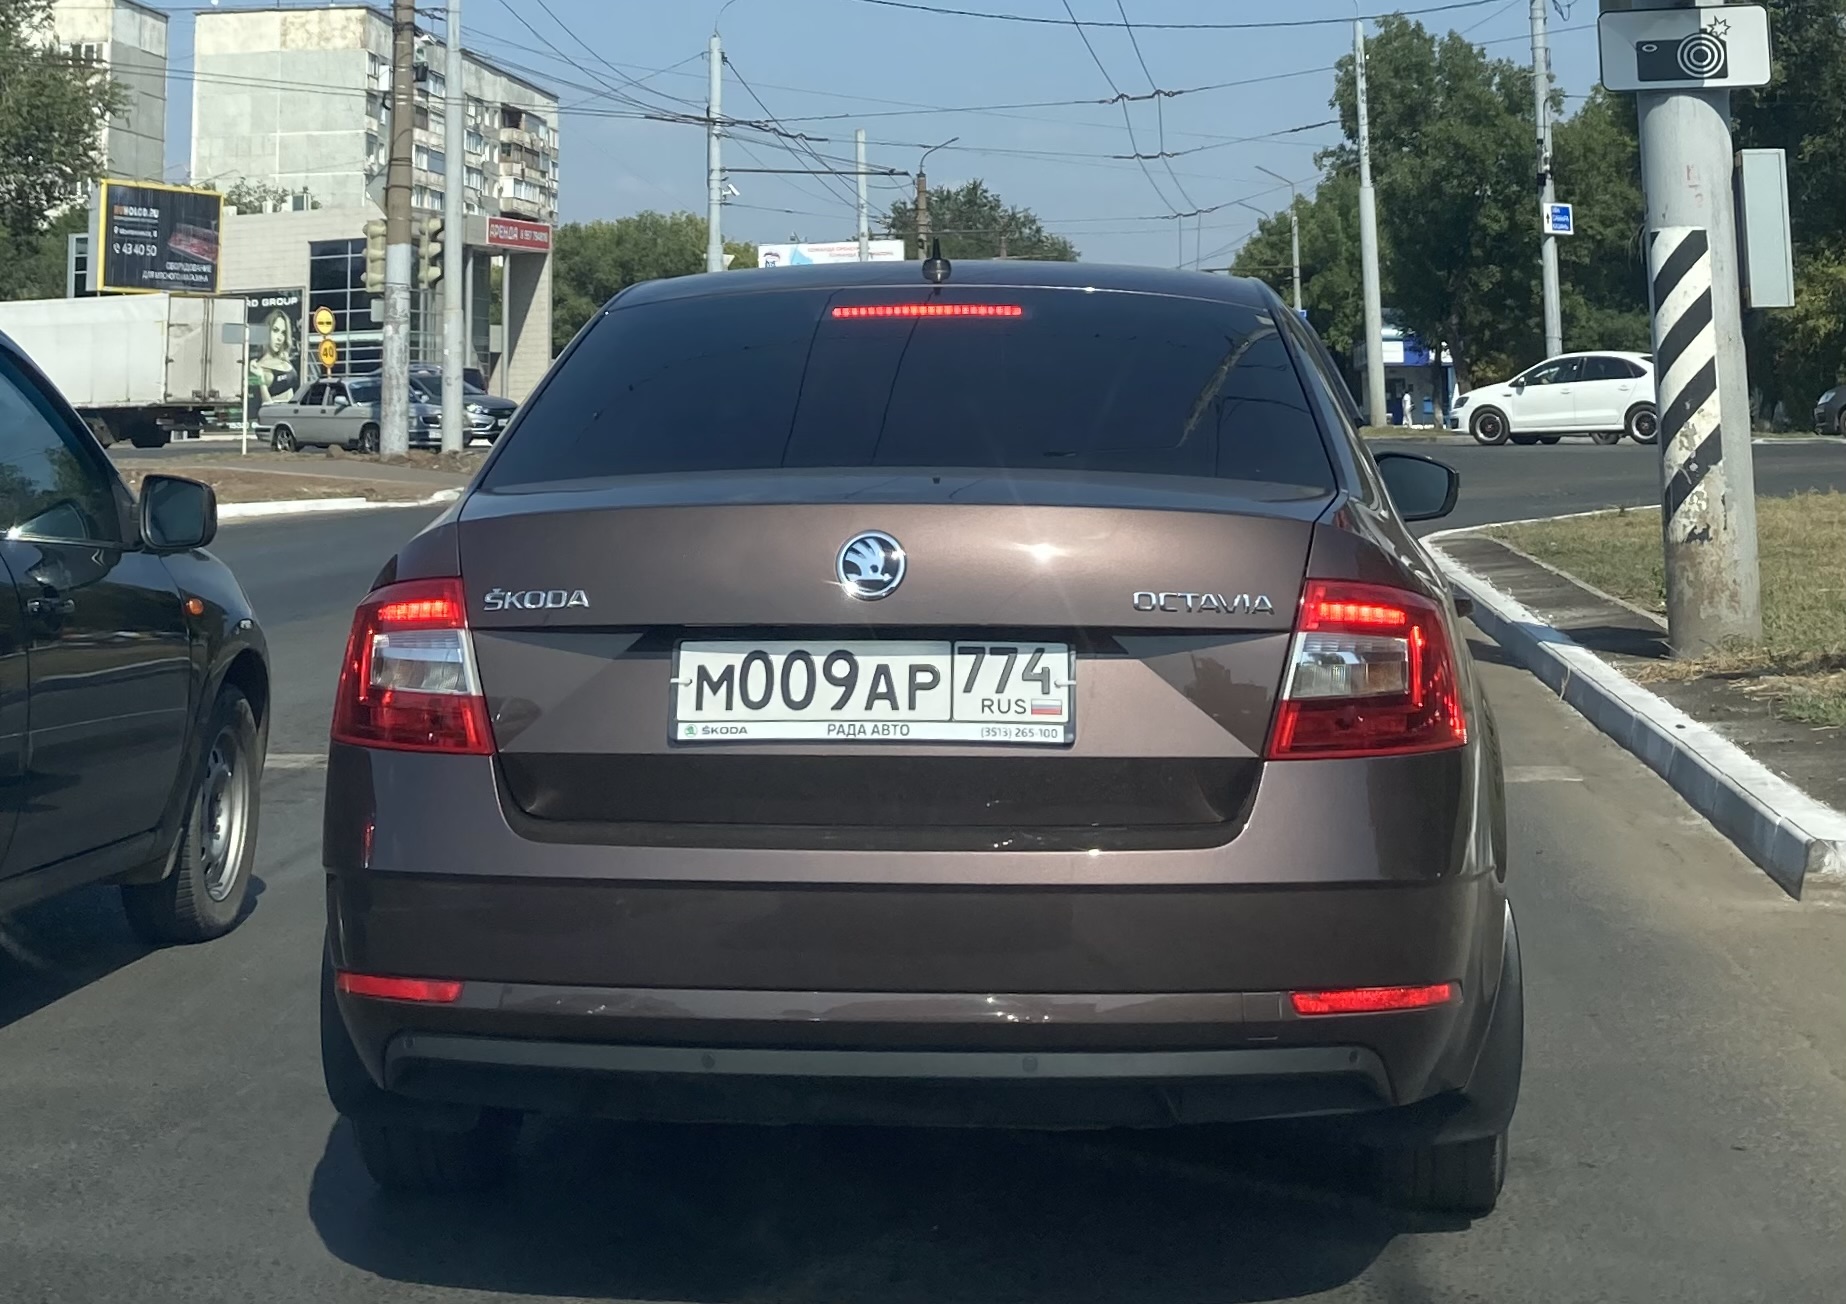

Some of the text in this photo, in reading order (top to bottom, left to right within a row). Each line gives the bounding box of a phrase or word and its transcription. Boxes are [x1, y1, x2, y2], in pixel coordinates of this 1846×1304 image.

[490, 224, 518, 240] АРЕНДА
[122, 243, 157, 257] 43 40 50
[261, 297, 298, 307] GROUP
[322, 346, 334, 358] 40
[483, 587, 590, 611] ŠKODA
[1132, 591, 1275, 616] OCTAVIA
[957, 646, 1051, 695] 774
[981, 698, 1027, 715] RUS
[701, 724, 749, 735] ŠKODA
[827, 723, 911, 738] РАДА АВТО
[980, 727, 1058, 739] (3513) 265-100
